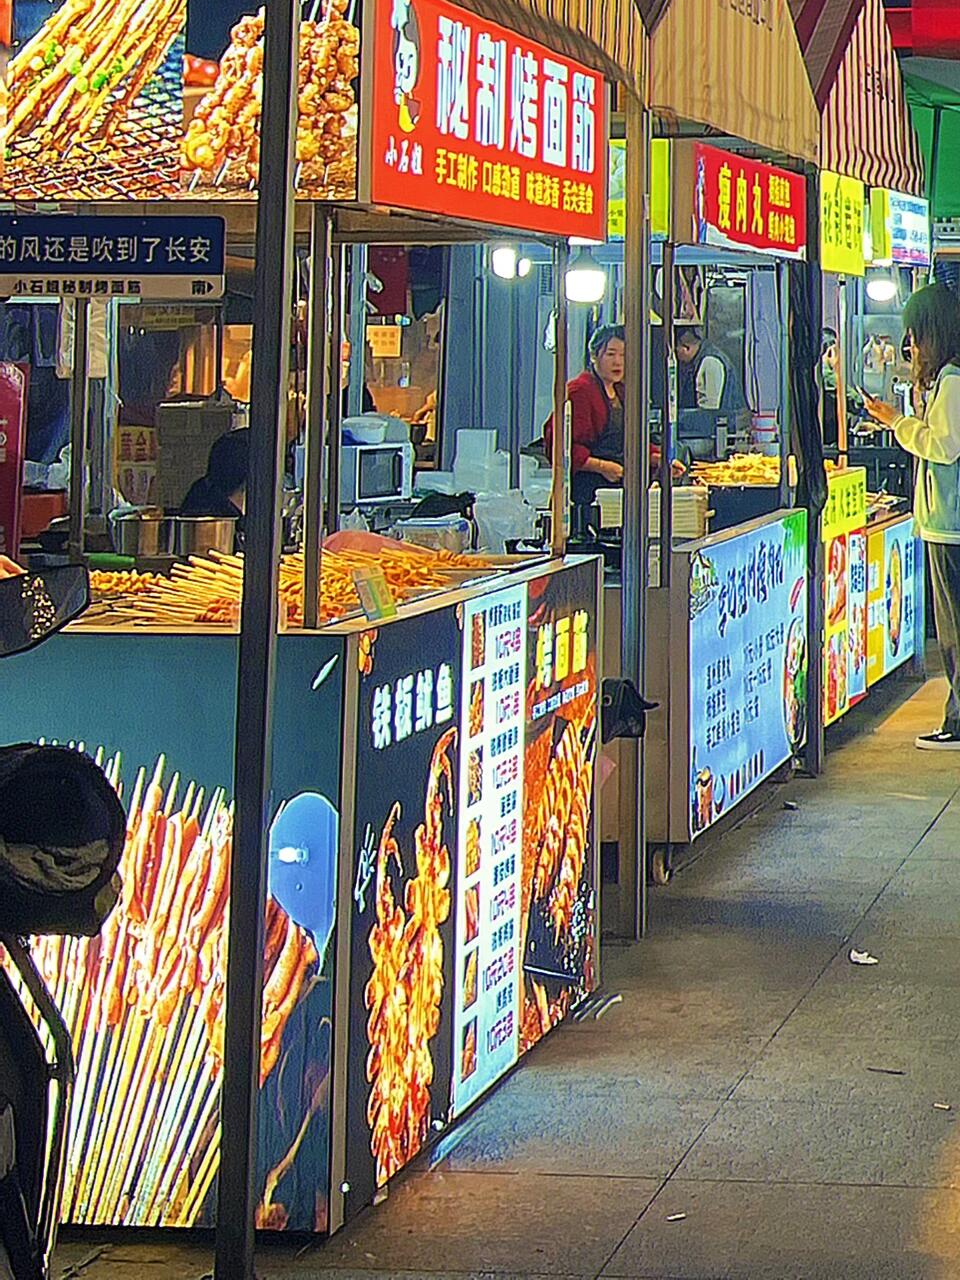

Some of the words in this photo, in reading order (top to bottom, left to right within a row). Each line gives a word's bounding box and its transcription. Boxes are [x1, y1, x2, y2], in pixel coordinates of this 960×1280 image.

[435, 14, 596, 175] 秘制烤面筋
[384, 135, 424, 176] 小石姐
[435, 148, 480, 193] 手工制作
[482, 160, 522, 202] 口感劲道
[718, 161, 764, 236] 瘦肉丸
[0, 235, 210, 263] 的风还是吹到了长安
[14, 279, 142, 295] 小石姐秘制烤面筋
[191, 280, 207, 296] 南
[535, 608, 589, 693] 烤面筋
[371, 661, 454, 751] 铁板鱿鱼
